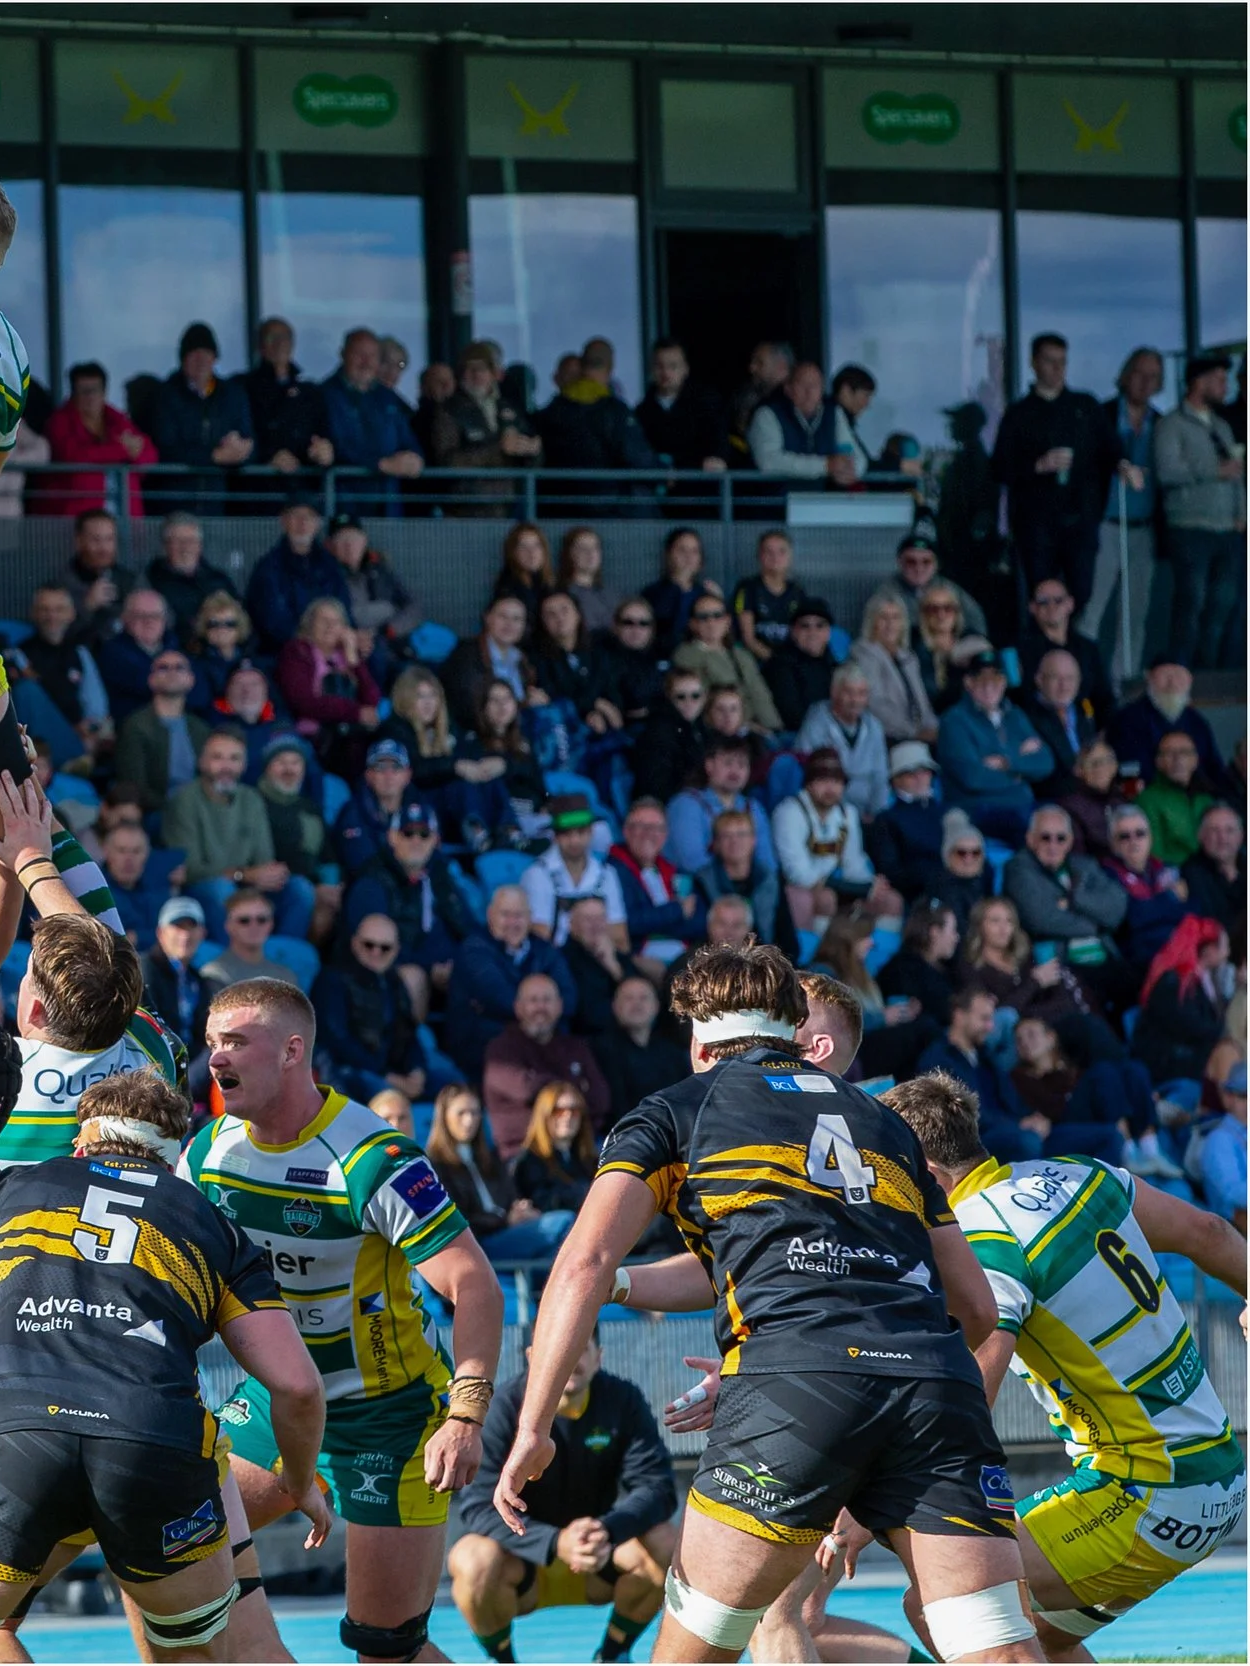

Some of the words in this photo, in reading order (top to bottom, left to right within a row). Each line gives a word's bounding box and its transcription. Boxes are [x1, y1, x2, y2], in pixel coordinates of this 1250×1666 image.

[771, 1081, 797, 1091] BCL
[807, 1113, 877, 1204] 4
[72, 1184, 145, 1264] 5
[787, 1256, 850, 1275] Wealth
[1095, 1229, 1160, 1316] 6
[17, 1296, 132, 1322] Advanta
[15, 1317, 73, 1333] Wealth
[368, 1314, 391, 1394] MOOREMentu
[860, 1350, 912, 1360] AKUMA
[58, 1408, 110, 1420] AKUMA
[350, 1492, 390, 1505] GILBERT
[713, 1468, 754, 1494] SURREY
[755, 1487, 796, 1506] HILLS
[721, 1488, 778, 1513] REMOVALS
